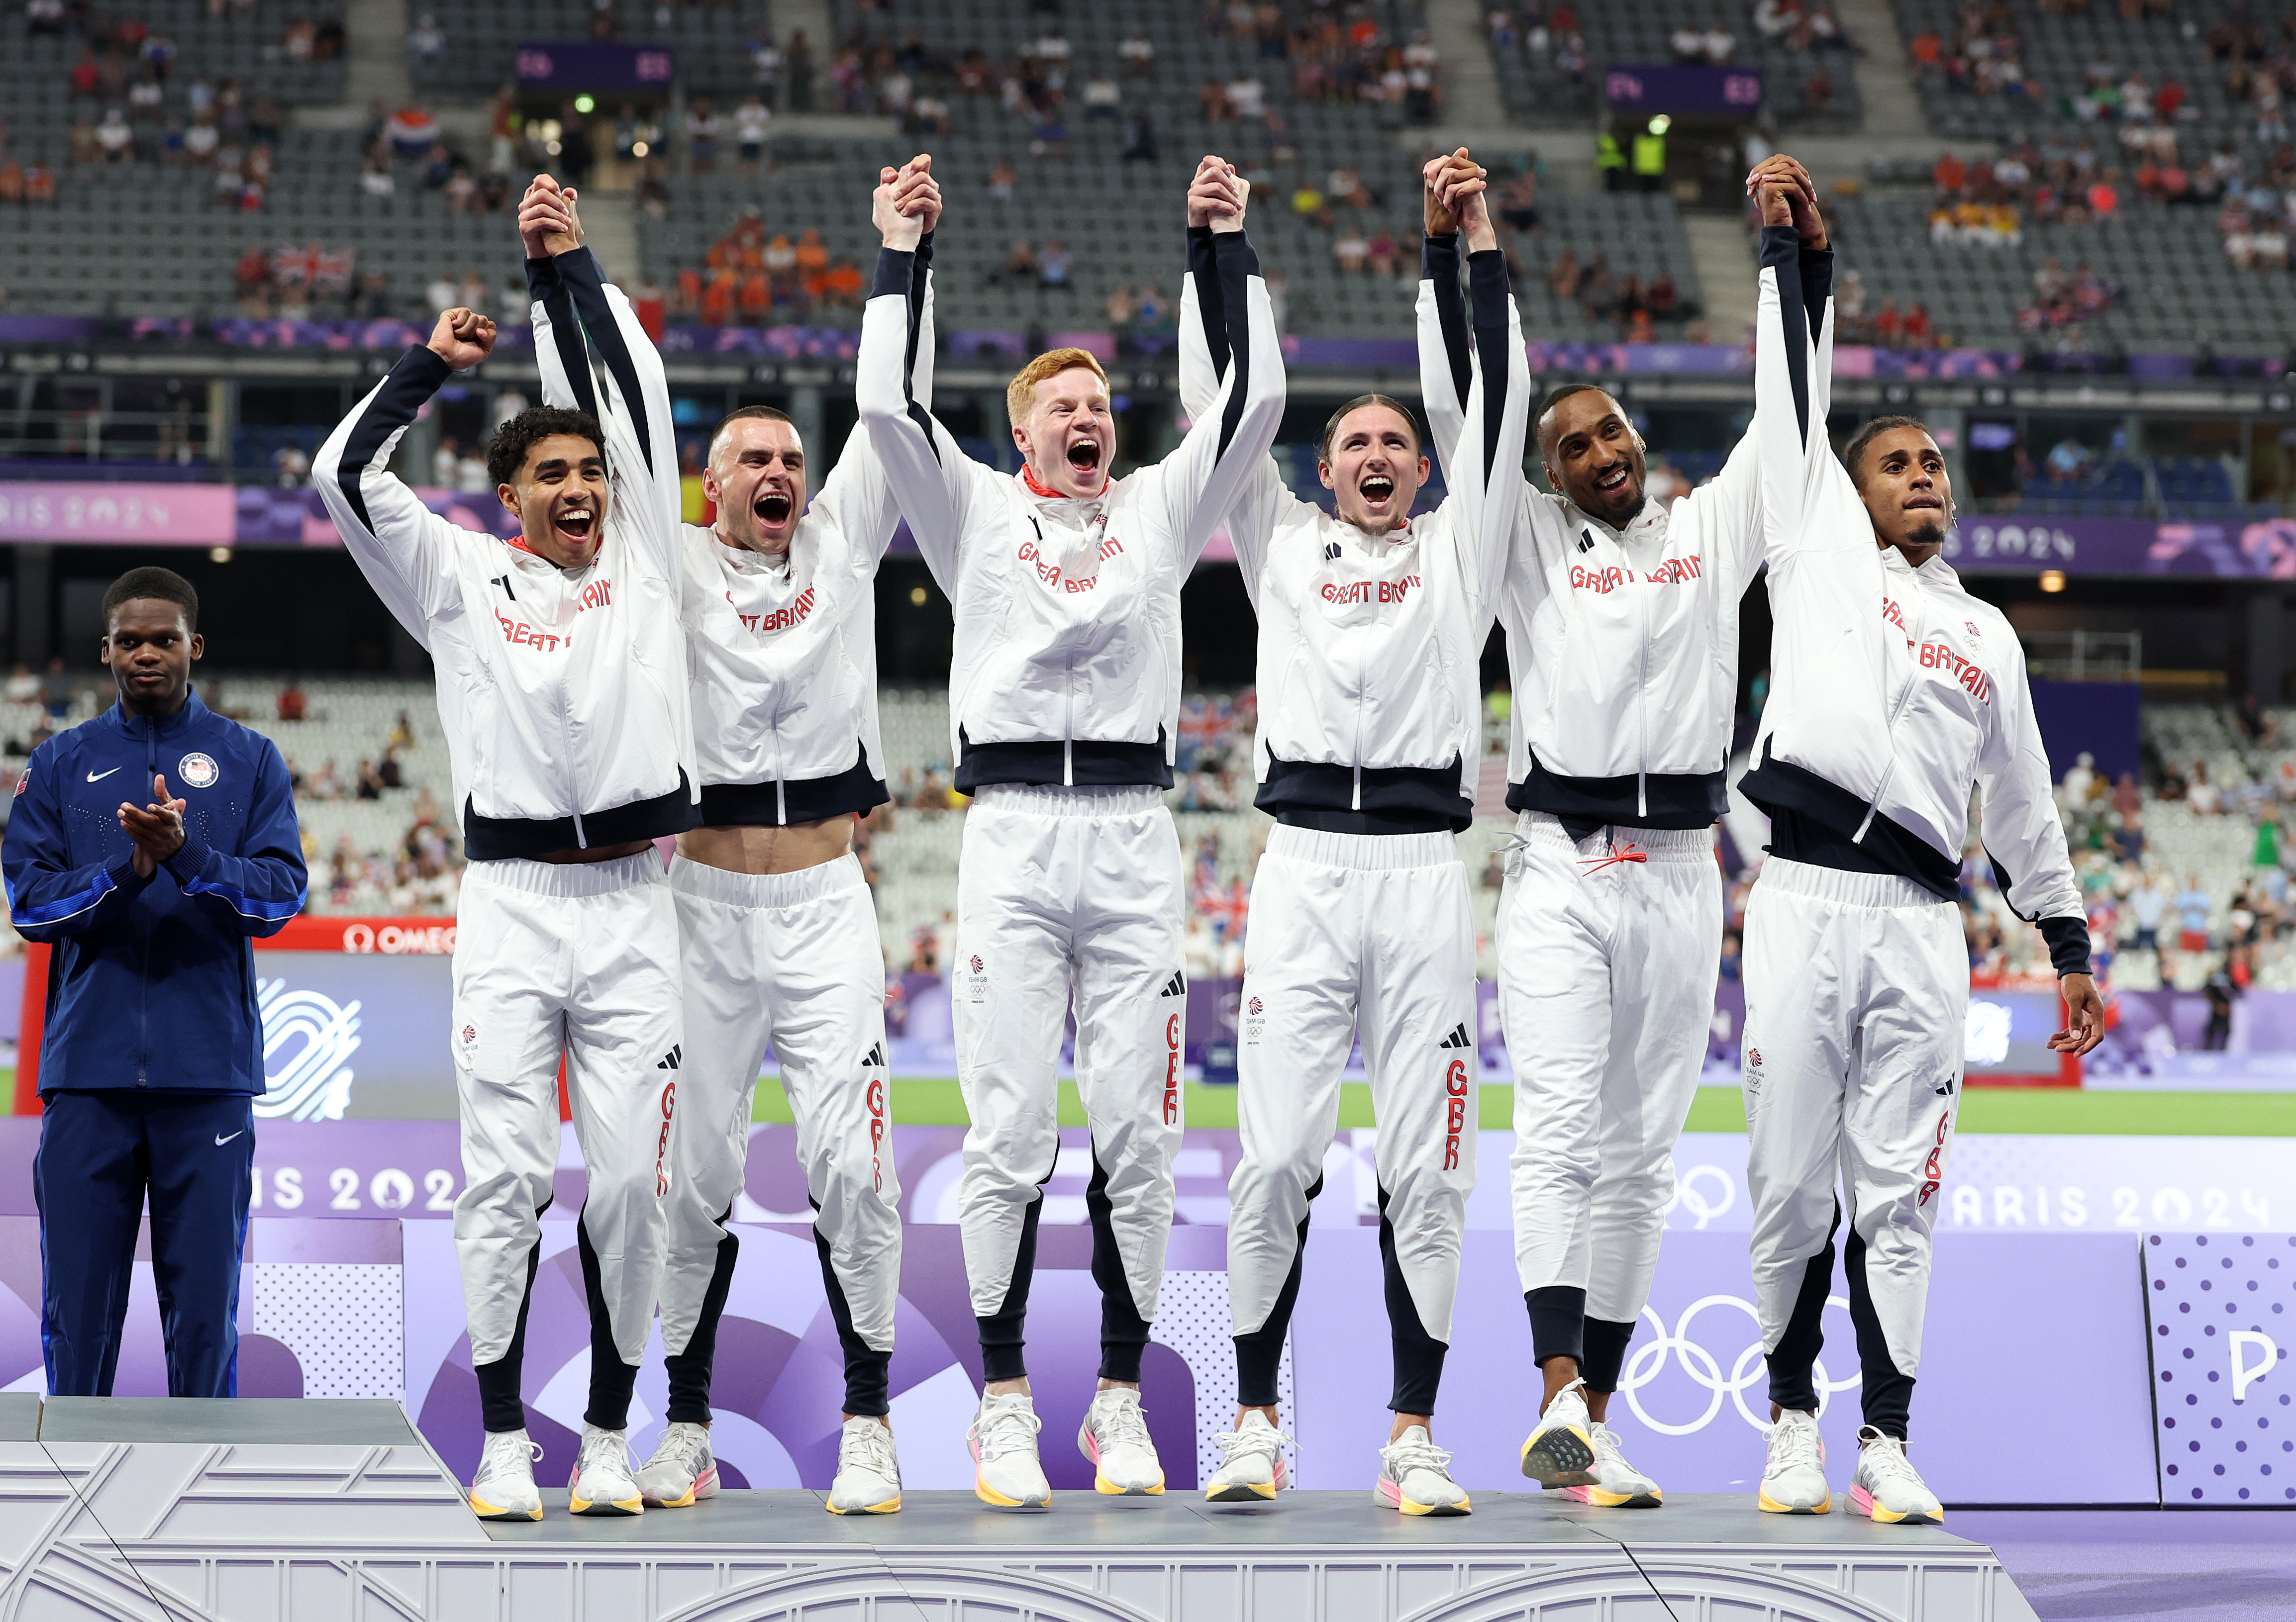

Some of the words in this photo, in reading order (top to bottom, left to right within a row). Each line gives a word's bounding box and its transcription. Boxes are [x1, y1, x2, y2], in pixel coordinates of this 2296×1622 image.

[1971, 524, 2076, 561] 2024
[1321, 581, 1372, 604] GREAT
[1745, 1066, 1757, 1075] TEAM
[1443, 1059, 1467, 1170] GBR
[1952, 1184, 2089, 1226] ARIS
[2111, 1186, 2270, 1228] 2024
[2229, 1331, 2278, 1400] P
